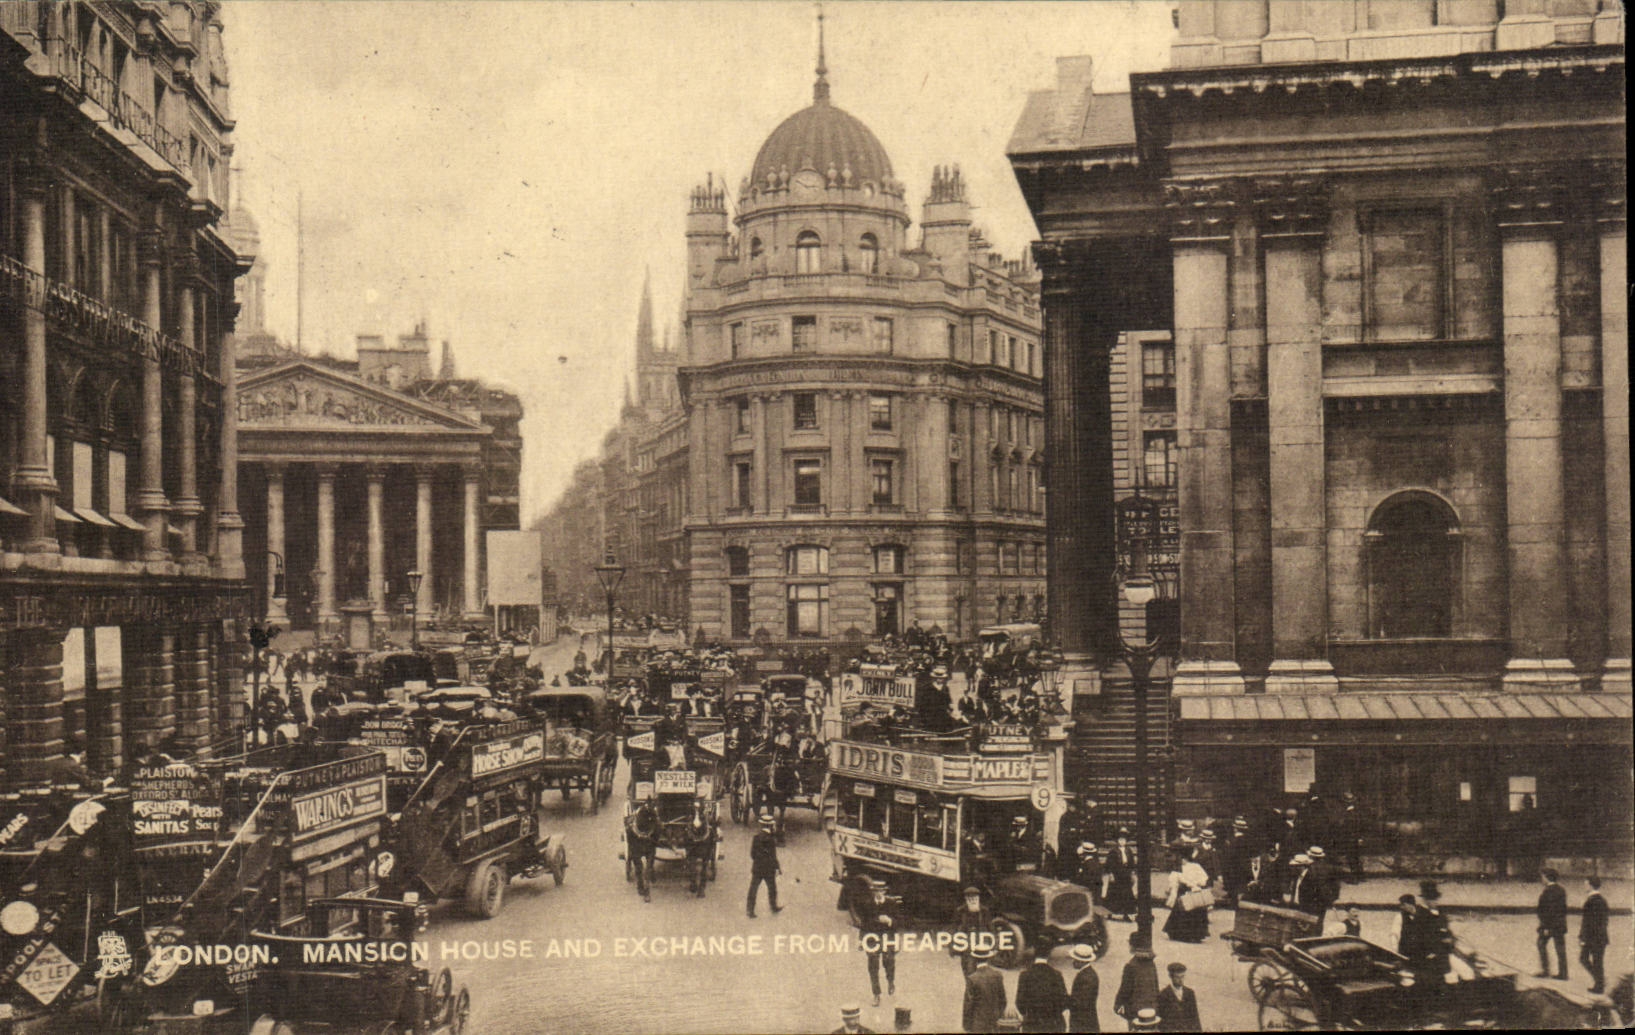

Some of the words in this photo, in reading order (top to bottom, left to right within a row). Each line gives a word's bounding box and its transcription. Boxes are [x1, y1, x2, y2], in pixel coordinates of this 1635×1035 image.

[856, 678, 886, 697] JOHN
[888, 680, 913, 698] BULL
[980, 723, 1034, 736] PUTNEY
[838, 745, 905, 777] IDRIS
[1038, 788, 1051, 807] 9
[25, 970, 42, 982] TO
[49, 963, 72, 979] LET
